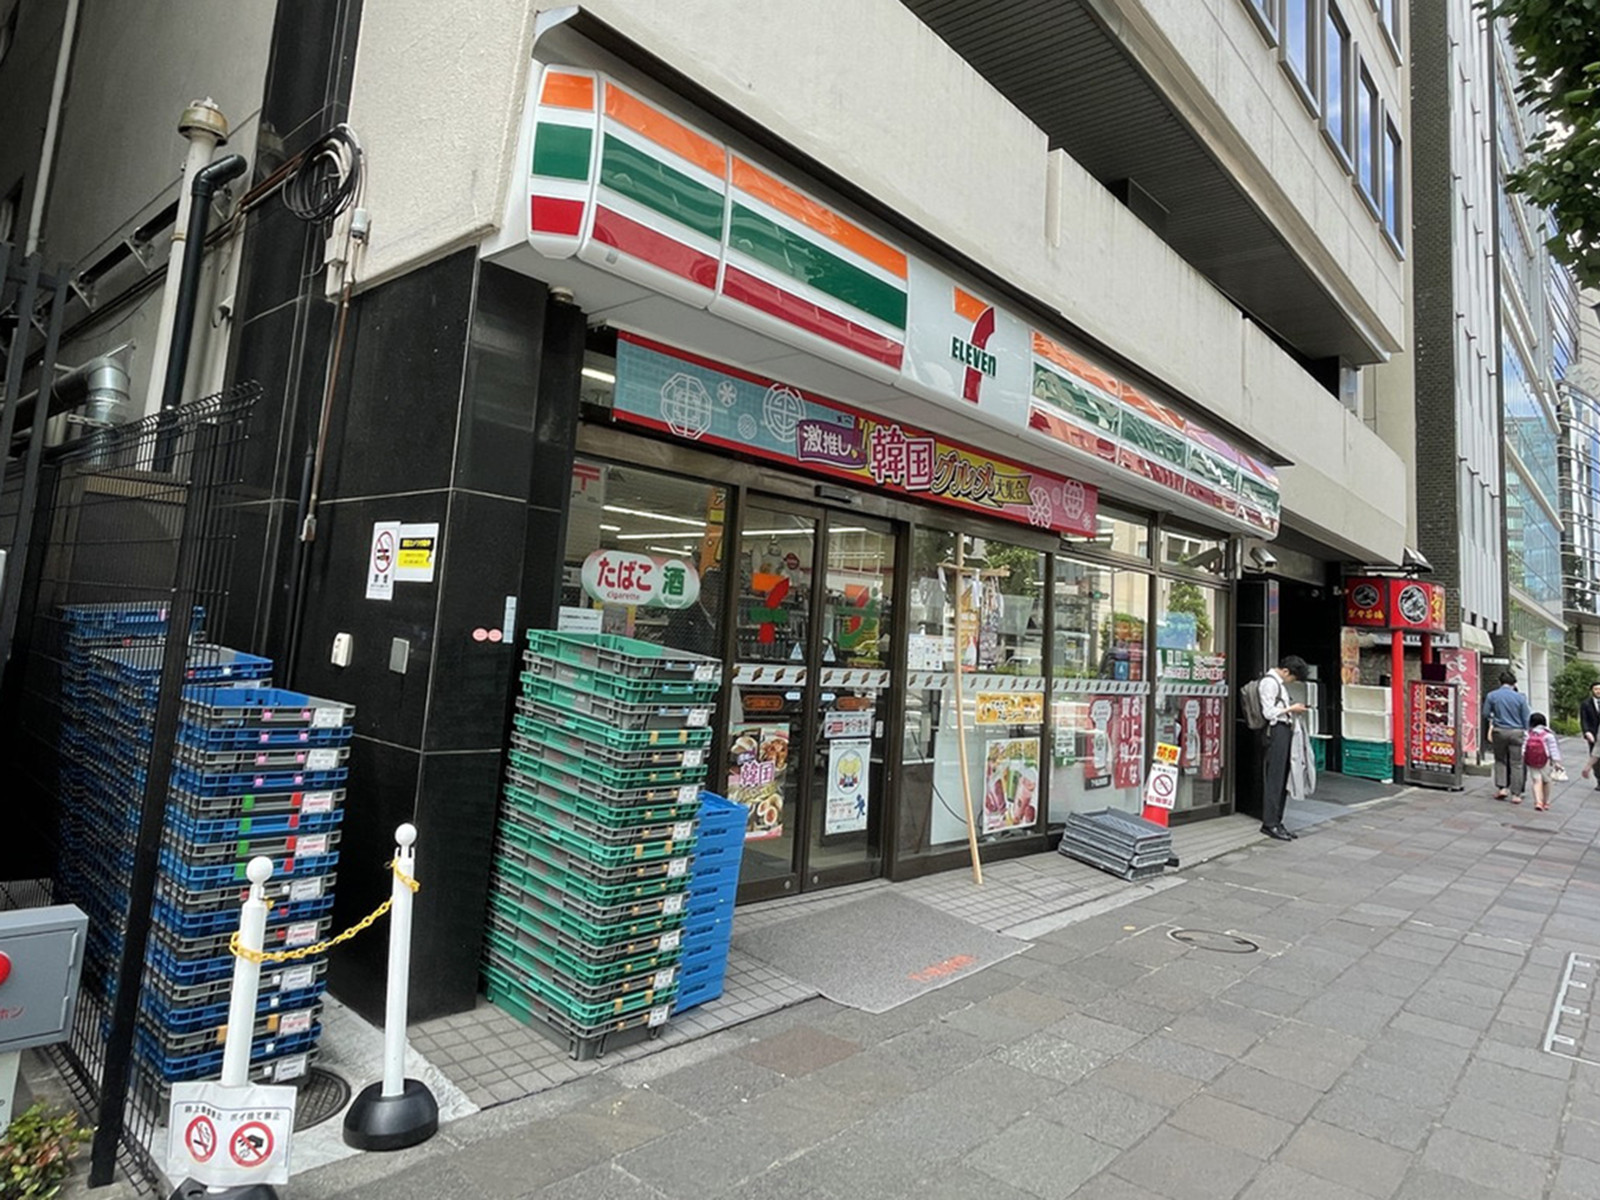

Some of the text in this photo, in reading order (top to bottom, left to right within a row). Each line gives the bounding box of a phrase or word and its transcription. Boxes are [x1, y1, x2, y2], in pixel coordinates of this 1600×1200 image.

[597, 557, 686, 596] たばこ 酒
